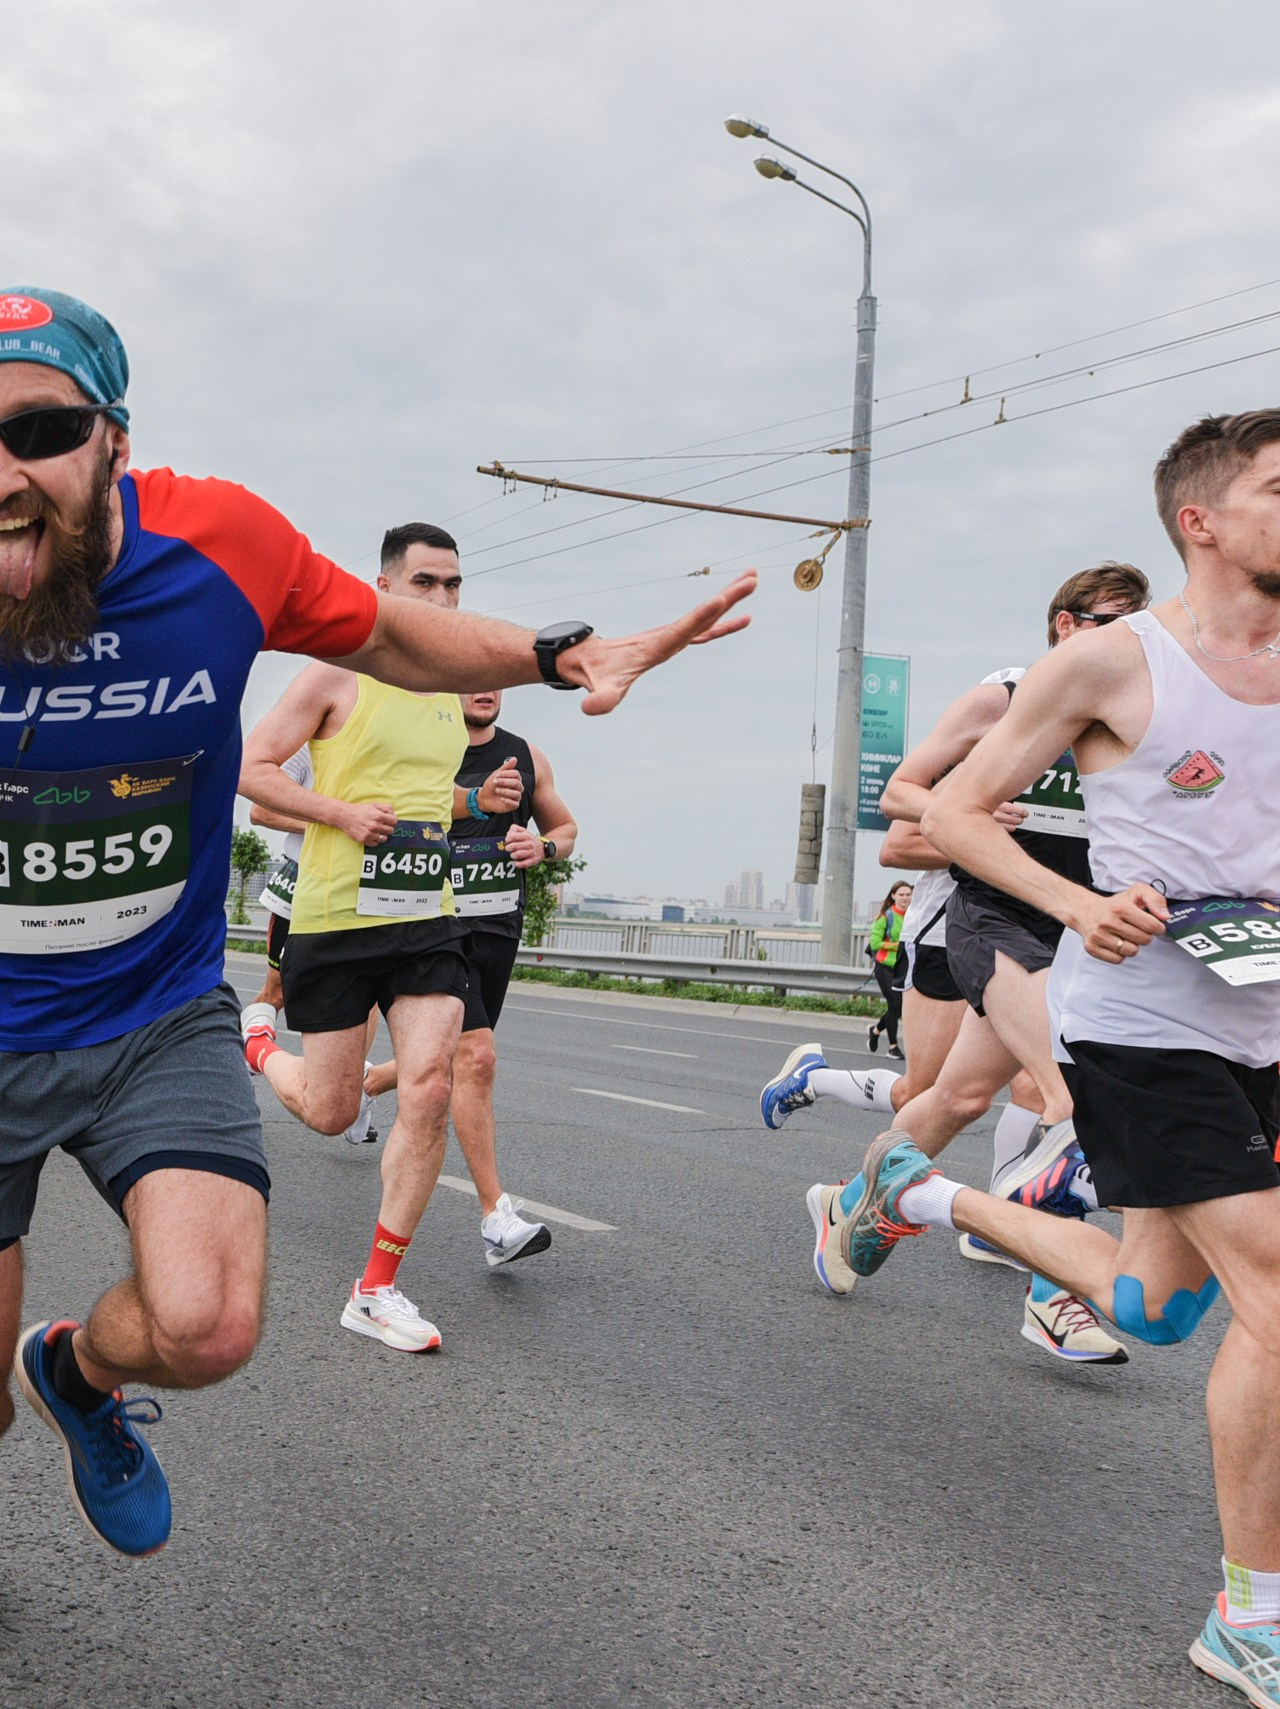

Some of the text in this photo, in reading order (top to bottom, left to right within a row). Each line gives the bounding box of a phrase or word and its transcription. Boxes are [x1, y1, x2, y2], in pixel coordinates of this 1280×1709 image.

[860, 785, 880, 795] 18:00
[22, 824, 173, 883] 8559
[363, 852, 443, 876] B 6450
[453, 860, 517, 884] B 7242
[116, 905, 148, 919] 2023
[1187, 920, 1280, 952] B 58
